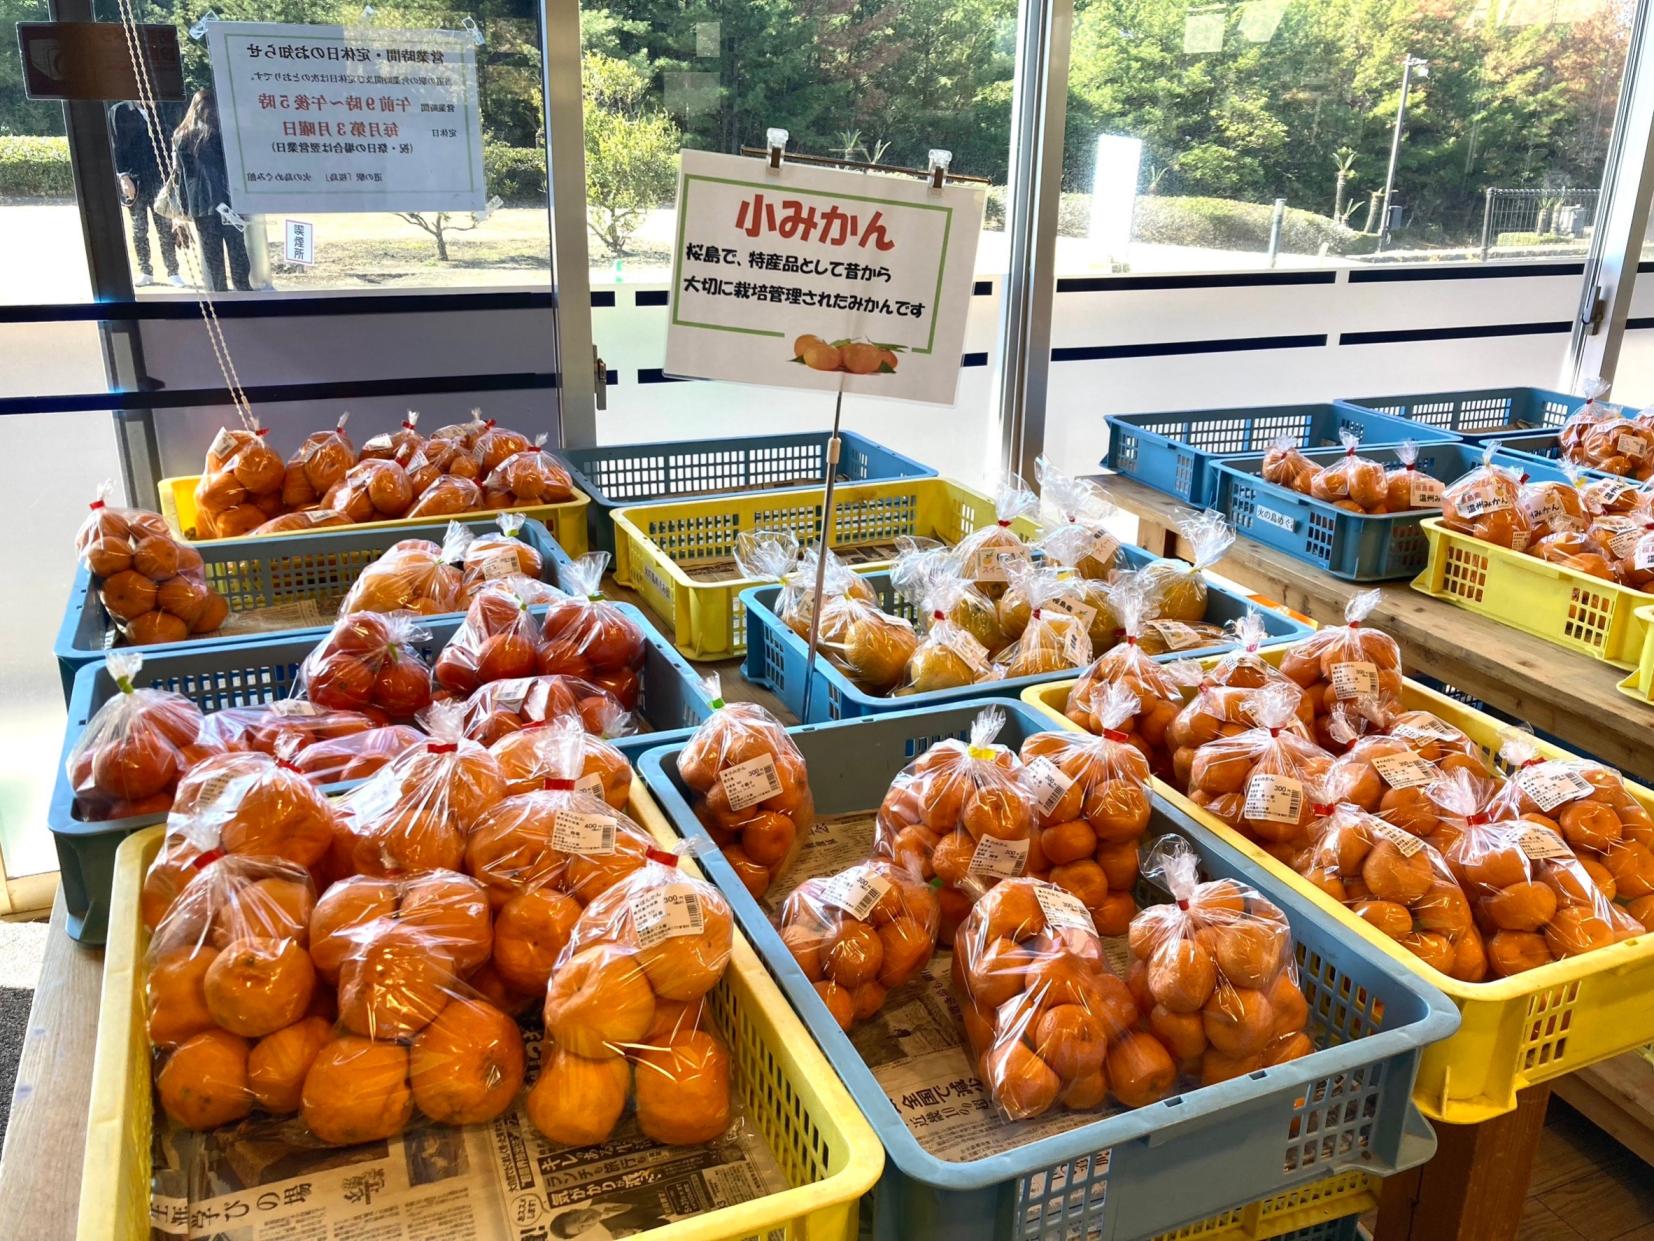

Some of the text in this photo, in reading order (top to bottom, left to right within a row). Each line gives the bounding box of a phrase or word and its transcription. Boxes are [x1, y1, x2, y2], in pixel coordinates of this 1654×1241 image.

[735, 193, 895, 252] 小みかん
[686, 242, 892, 283] 桜島で、特産品として昔から
[683, 275, 926, 318] 大切に栽培管理されたみかんです
[1257, 507, 1293, 530] 火の島めぐ
[1467, 498, 1510, 515] 温州みかん
